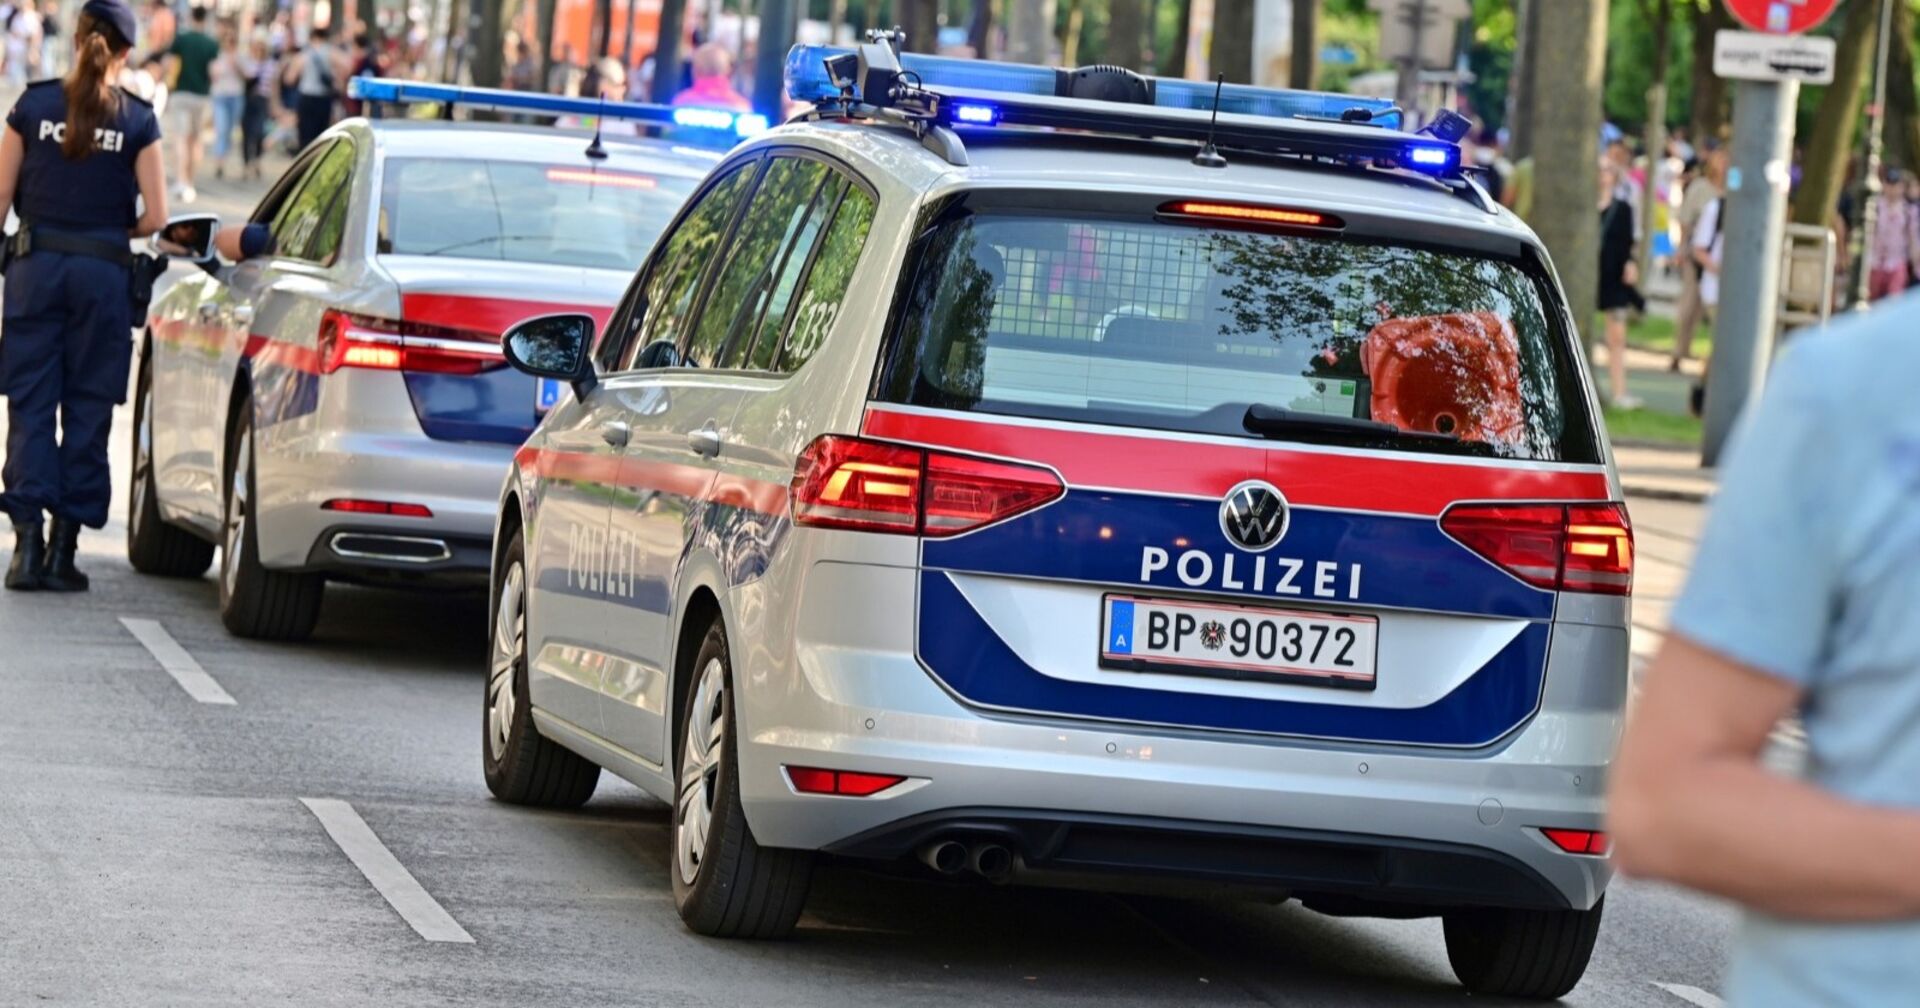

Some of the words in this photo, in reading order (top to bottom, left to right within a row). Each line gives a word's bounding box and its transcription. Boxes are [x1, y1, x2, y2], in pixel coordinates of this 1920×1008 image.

[567, 522, 637, 599] POLIZEI
[1141, 546, 1361, 599] POLIZEI
[1115, 634, 1127, 648] A
[1148, 611, 1196, 652] BP
[1229, 618, 1356, 667] 90372
